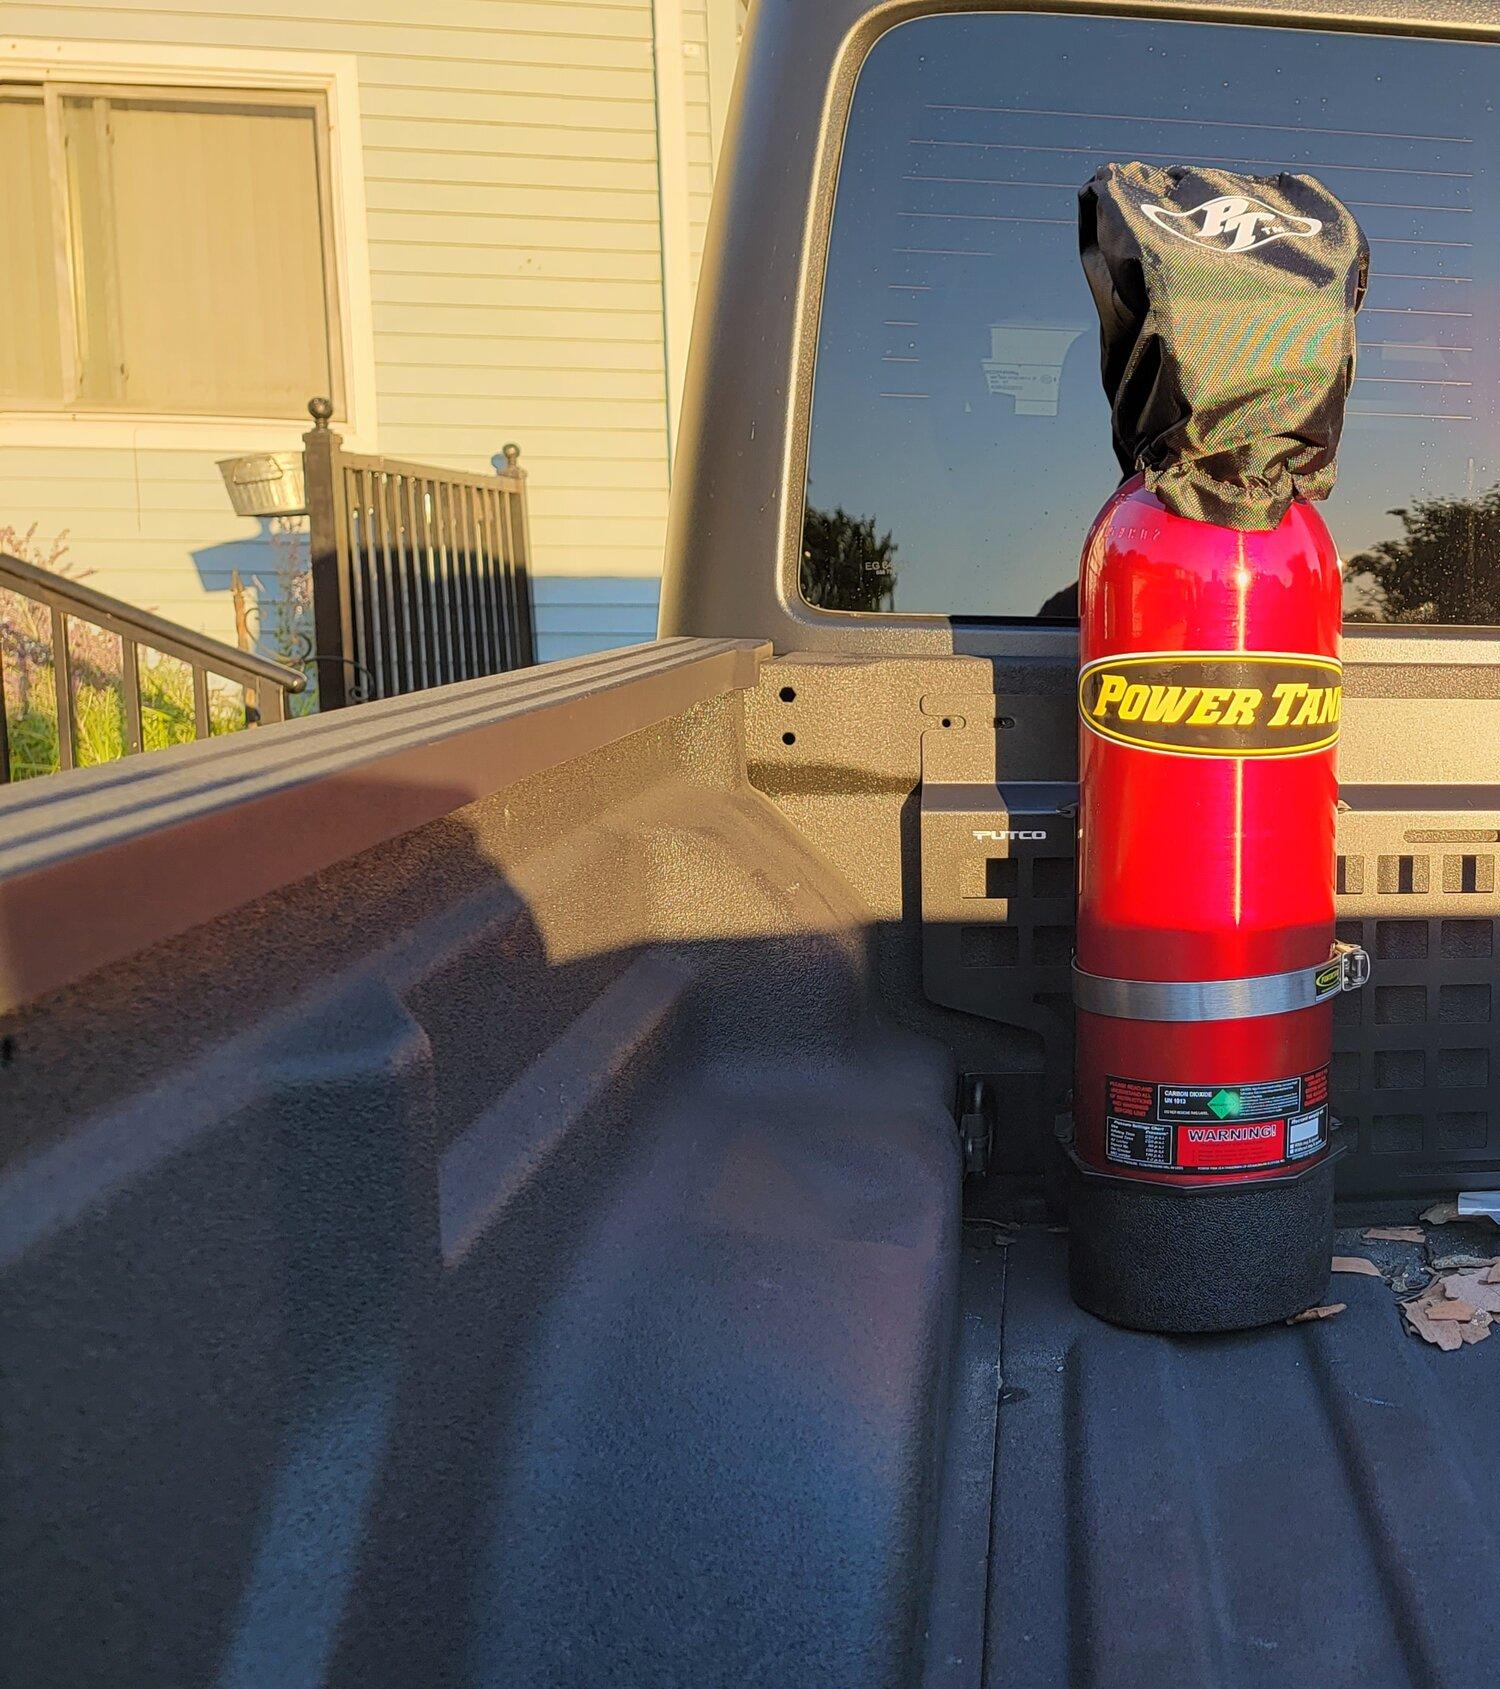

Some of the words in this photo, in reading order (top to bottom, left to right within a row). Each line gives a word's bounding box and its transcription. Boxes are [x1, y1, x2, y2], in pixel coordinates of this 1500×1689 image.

[1092, 673, 1264, 727] POWER
[972, 830, 1047, 841] PUTCO
[1164, 1090, 1189, 1098] CARBON
[1188, 1124, 1277, 1142] WARNING!
